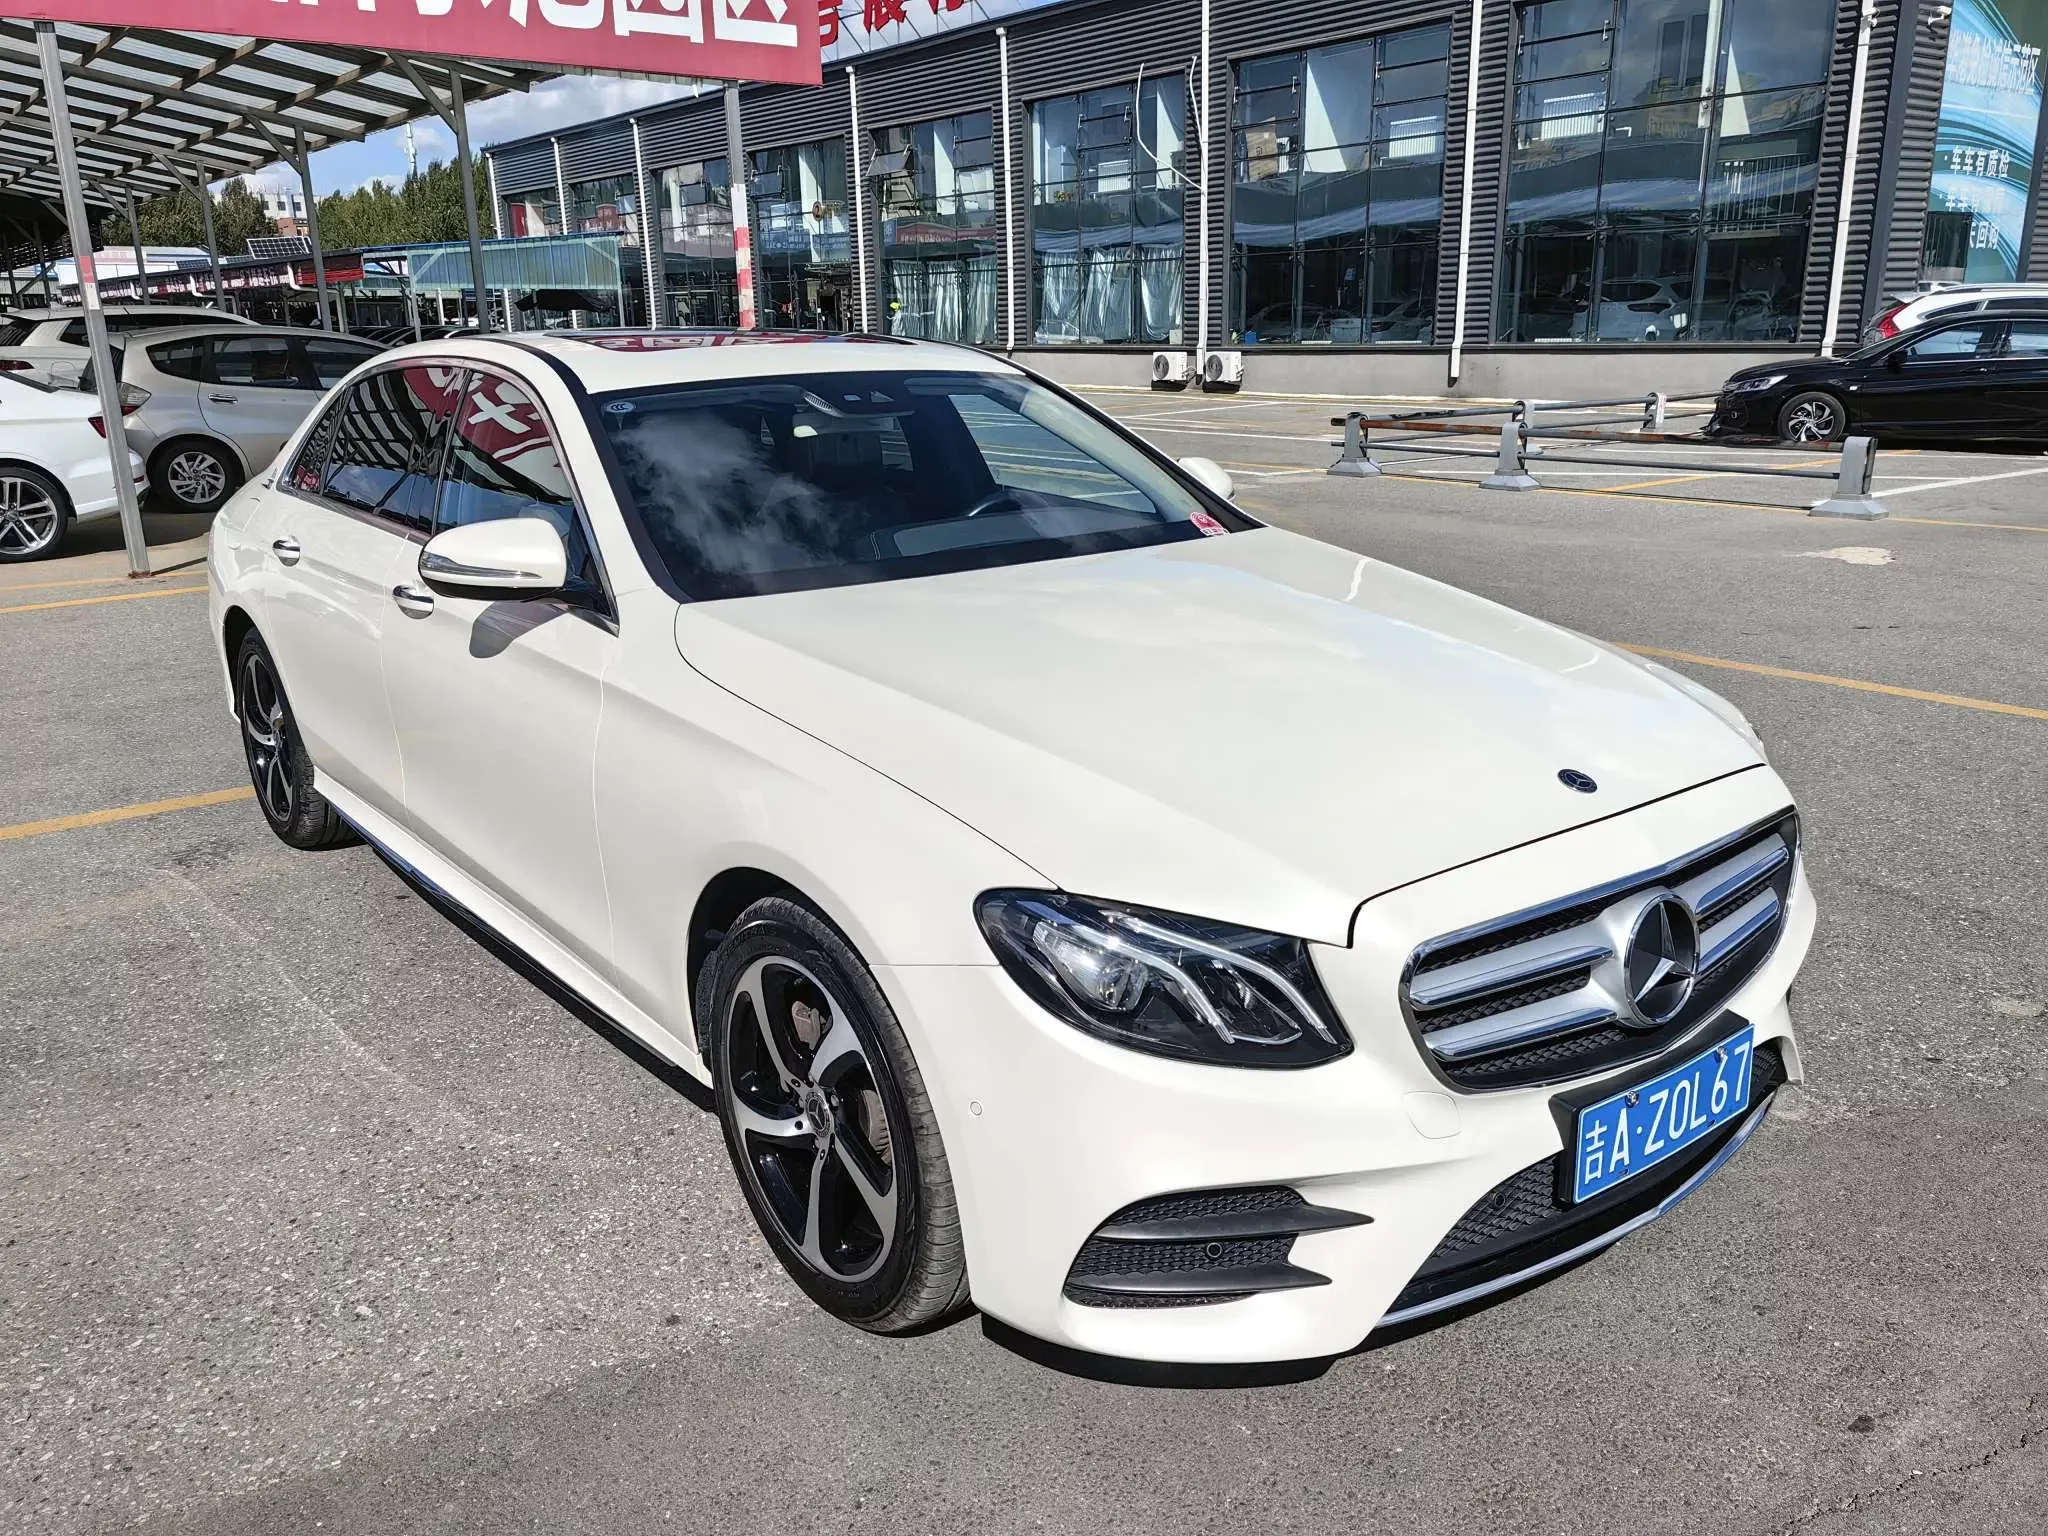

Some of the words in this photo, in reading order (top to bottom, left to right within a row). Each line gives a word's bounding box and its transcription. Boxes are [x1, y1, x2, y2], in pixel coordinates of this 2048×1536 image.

[1950, 145, 2010, 177] 车车有质检
